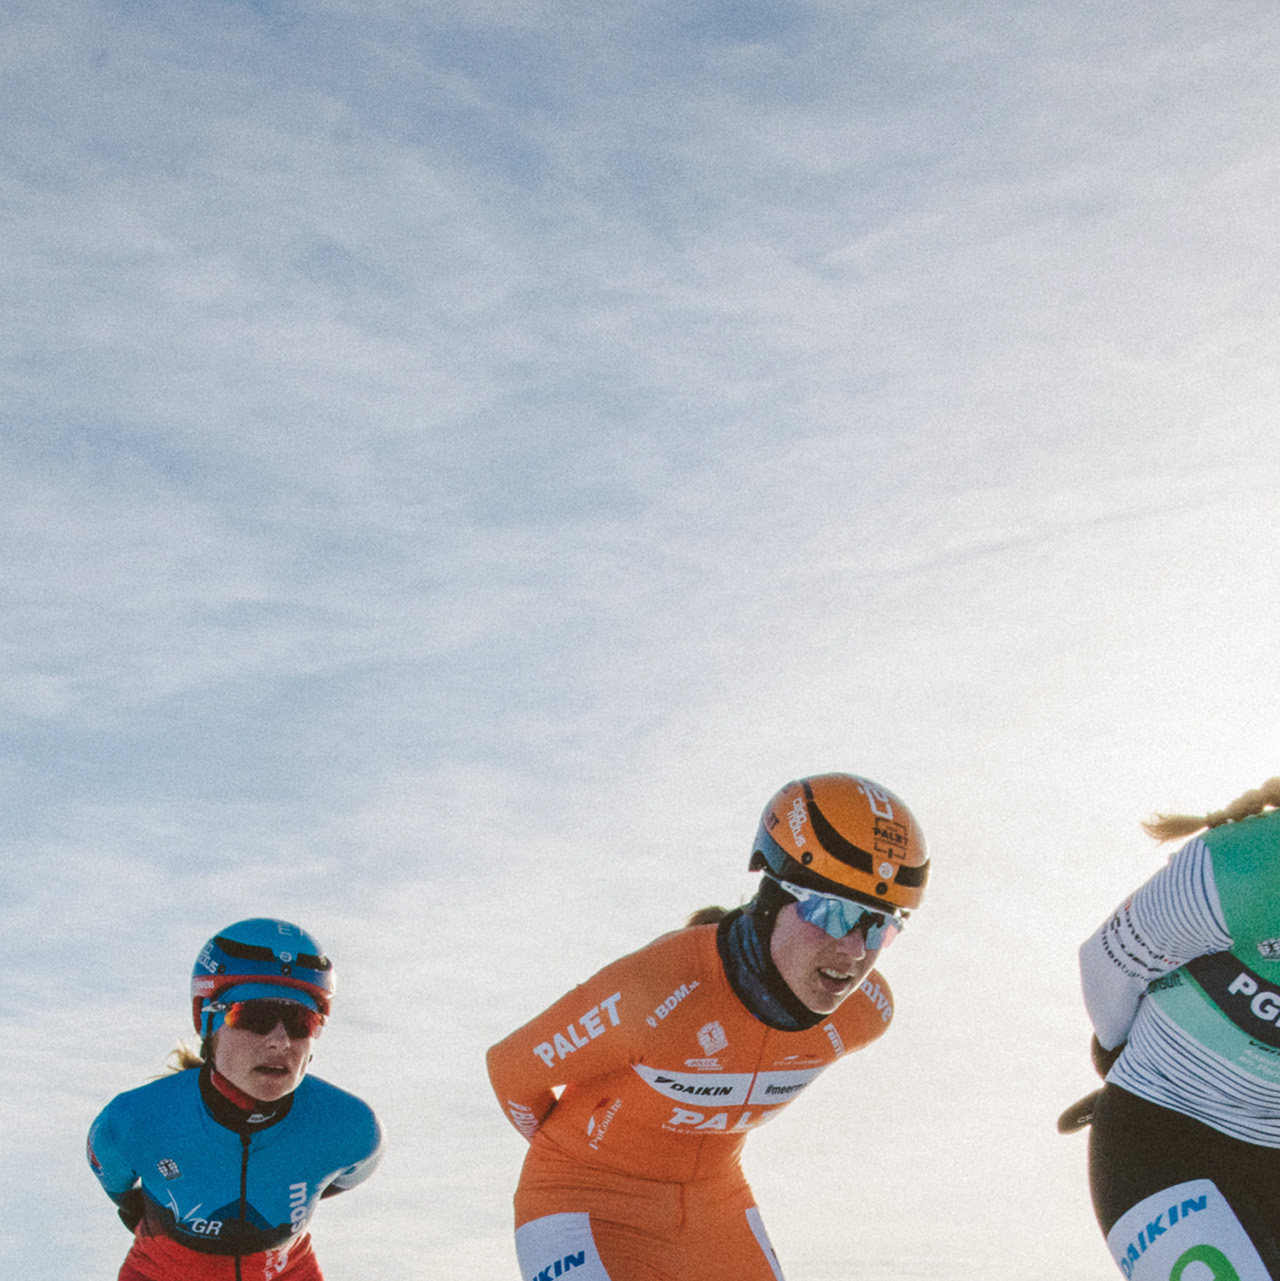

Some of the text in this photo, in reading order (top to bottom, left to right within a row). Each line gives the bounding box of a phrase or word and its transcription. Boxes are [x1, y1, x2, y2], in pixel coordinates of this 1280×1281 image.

[533, 992, 622, 1068] PALET
[670, 1083, 734, 1097] DAIKIN
[288, 1181, 309, 1234] mas
